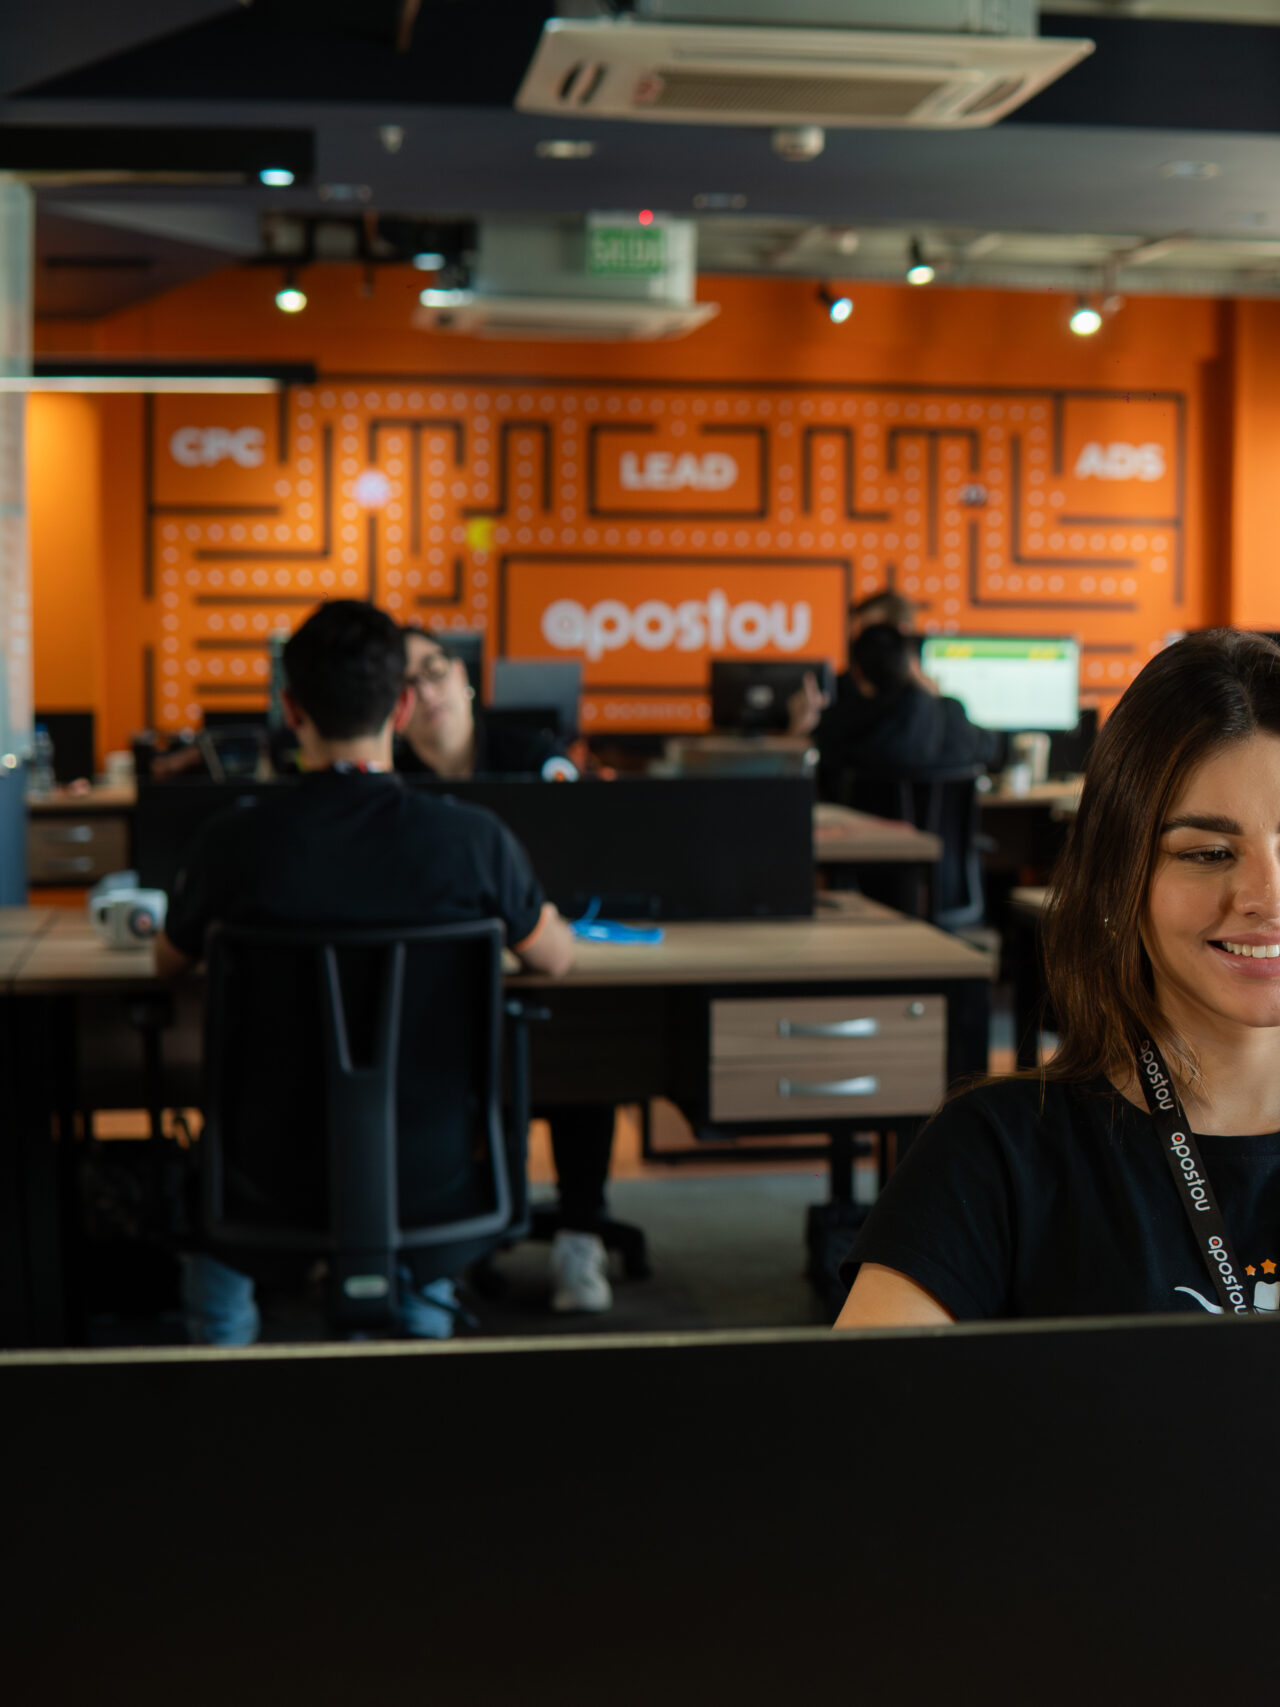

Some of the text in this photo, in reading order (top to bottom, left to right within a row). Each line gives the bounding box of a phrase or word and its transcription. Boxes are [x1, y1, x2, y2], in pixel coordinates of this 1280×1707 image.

[170, 427, 265, 467] CPC
[620, 451, 738, 491] LEAD
[1075, 442, 1165, 482] ADS
[542, 589, 811, 662] apostou
[1140, 1040, 1175, 1110] apostou
[1170, 1131, 1211, 1211] apostou
[1208, 1235, 1249, 1315] apostou
